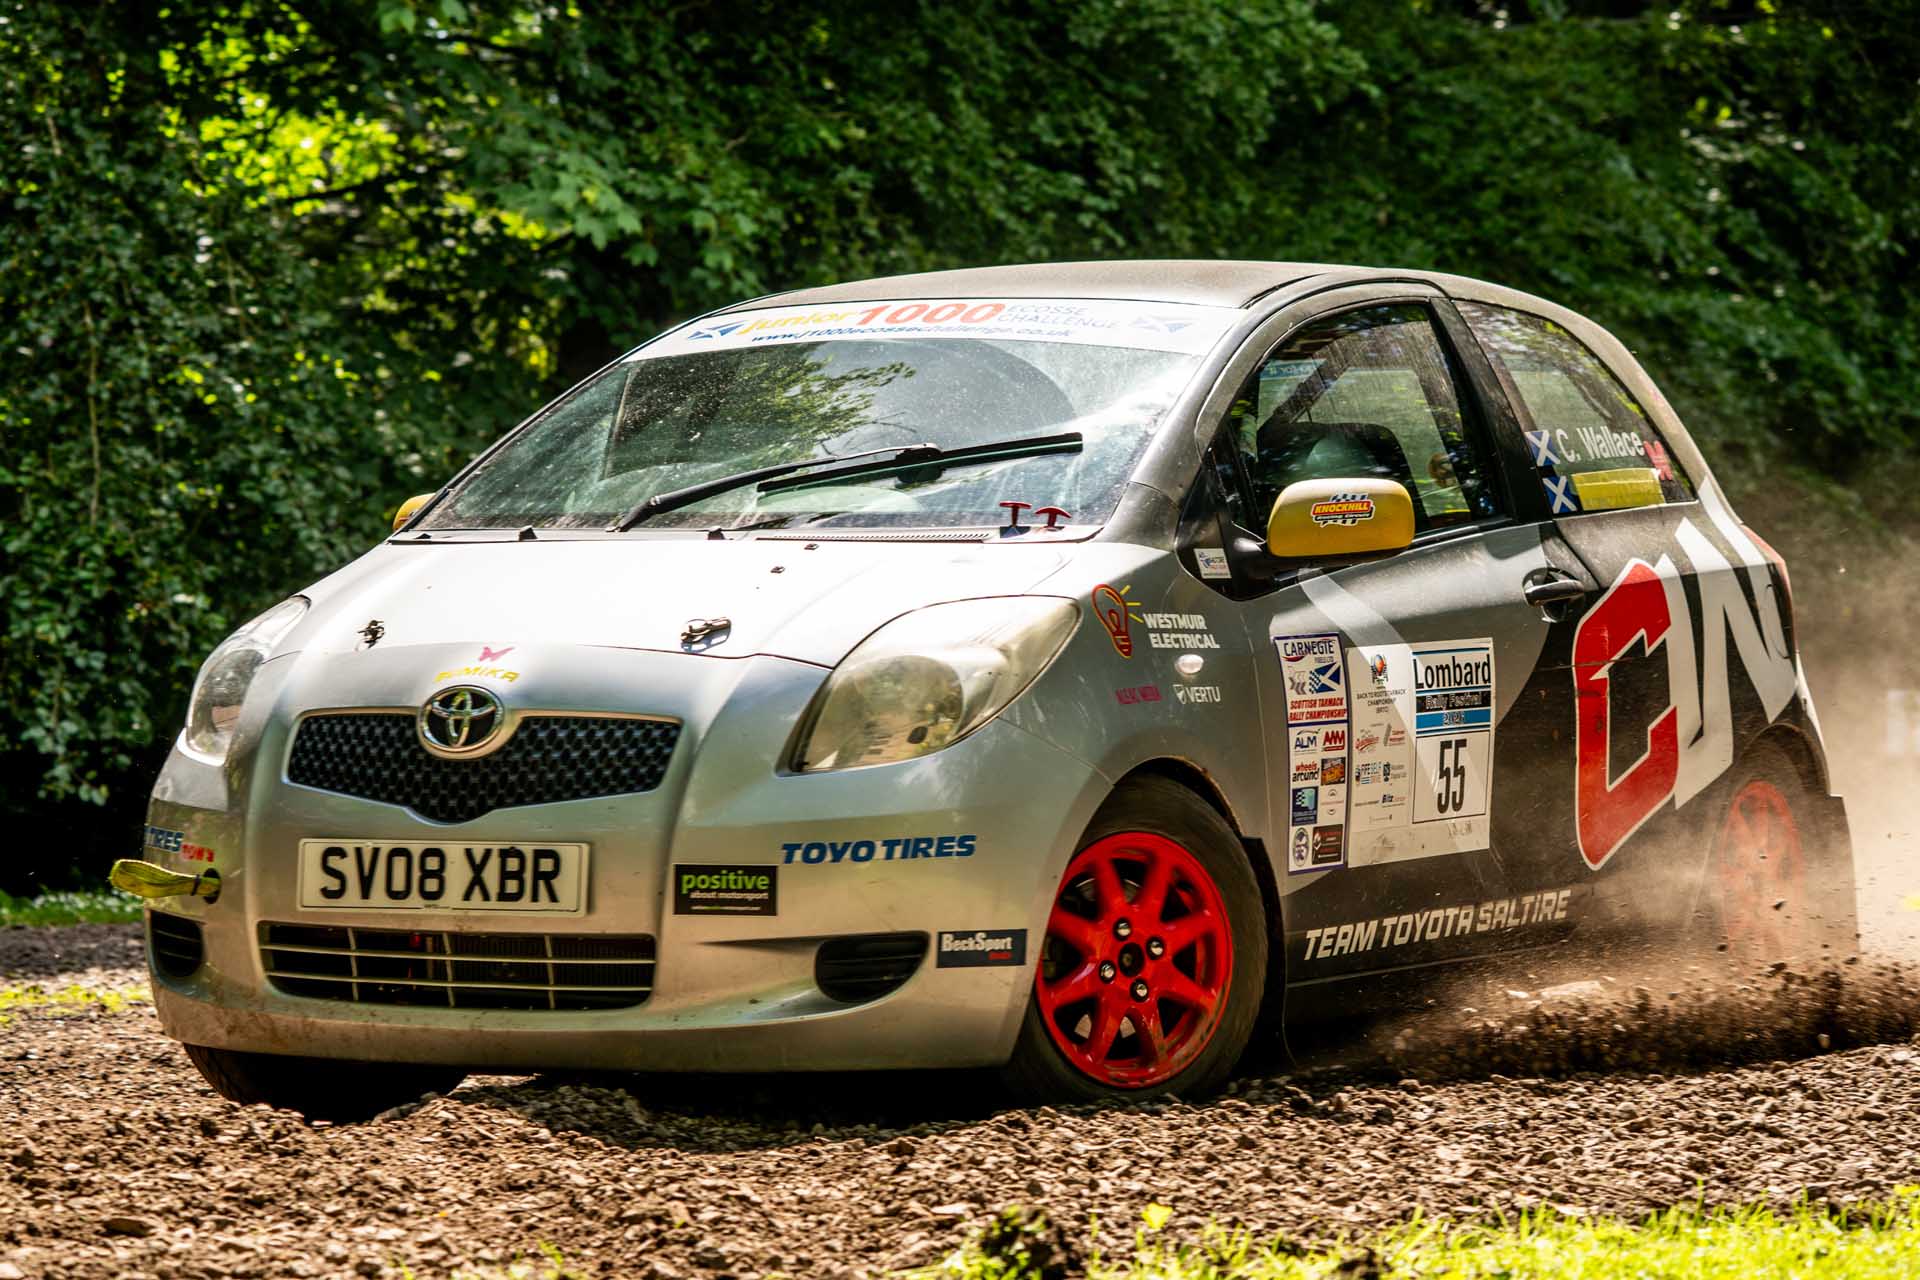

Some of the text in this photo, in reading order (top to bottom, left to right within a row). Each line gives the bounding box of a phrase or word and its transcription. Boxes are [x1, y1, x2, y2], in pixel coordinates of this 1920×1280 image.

[855, 302, 1006, 327] 1000
[1555, 425, 1646, 463] C. Wallace
[1314, 502, 1369, 514] KNOCKHILL
[1142, 612, 1208, 630] WESTMUIR
[1148, 633, 1221, 649] ELECTRICAL
[1283, 639, 1335, 657] CARNEGIE
[1413, 654, 1491, 690] Lombard
[1185, 685, 1222, 703] VERTU
[1290, 699, 1318, 710] SCOTTISH
[1305, 708, 1348, 720] CHAMPIONSHIP
[1292, 767, 1320, 782] around
[1295, 760, 1318, 773] wheels
[1436, 738, 1468, 815] 55
[781, 834, 977, 865] TOYO TIRES
[319, 845, 561, 904] SV08 XBR
[681, 869, 770, 895] positive
[1303, 889, 1572, 961] TEAM TOYOTA SALTIRE
